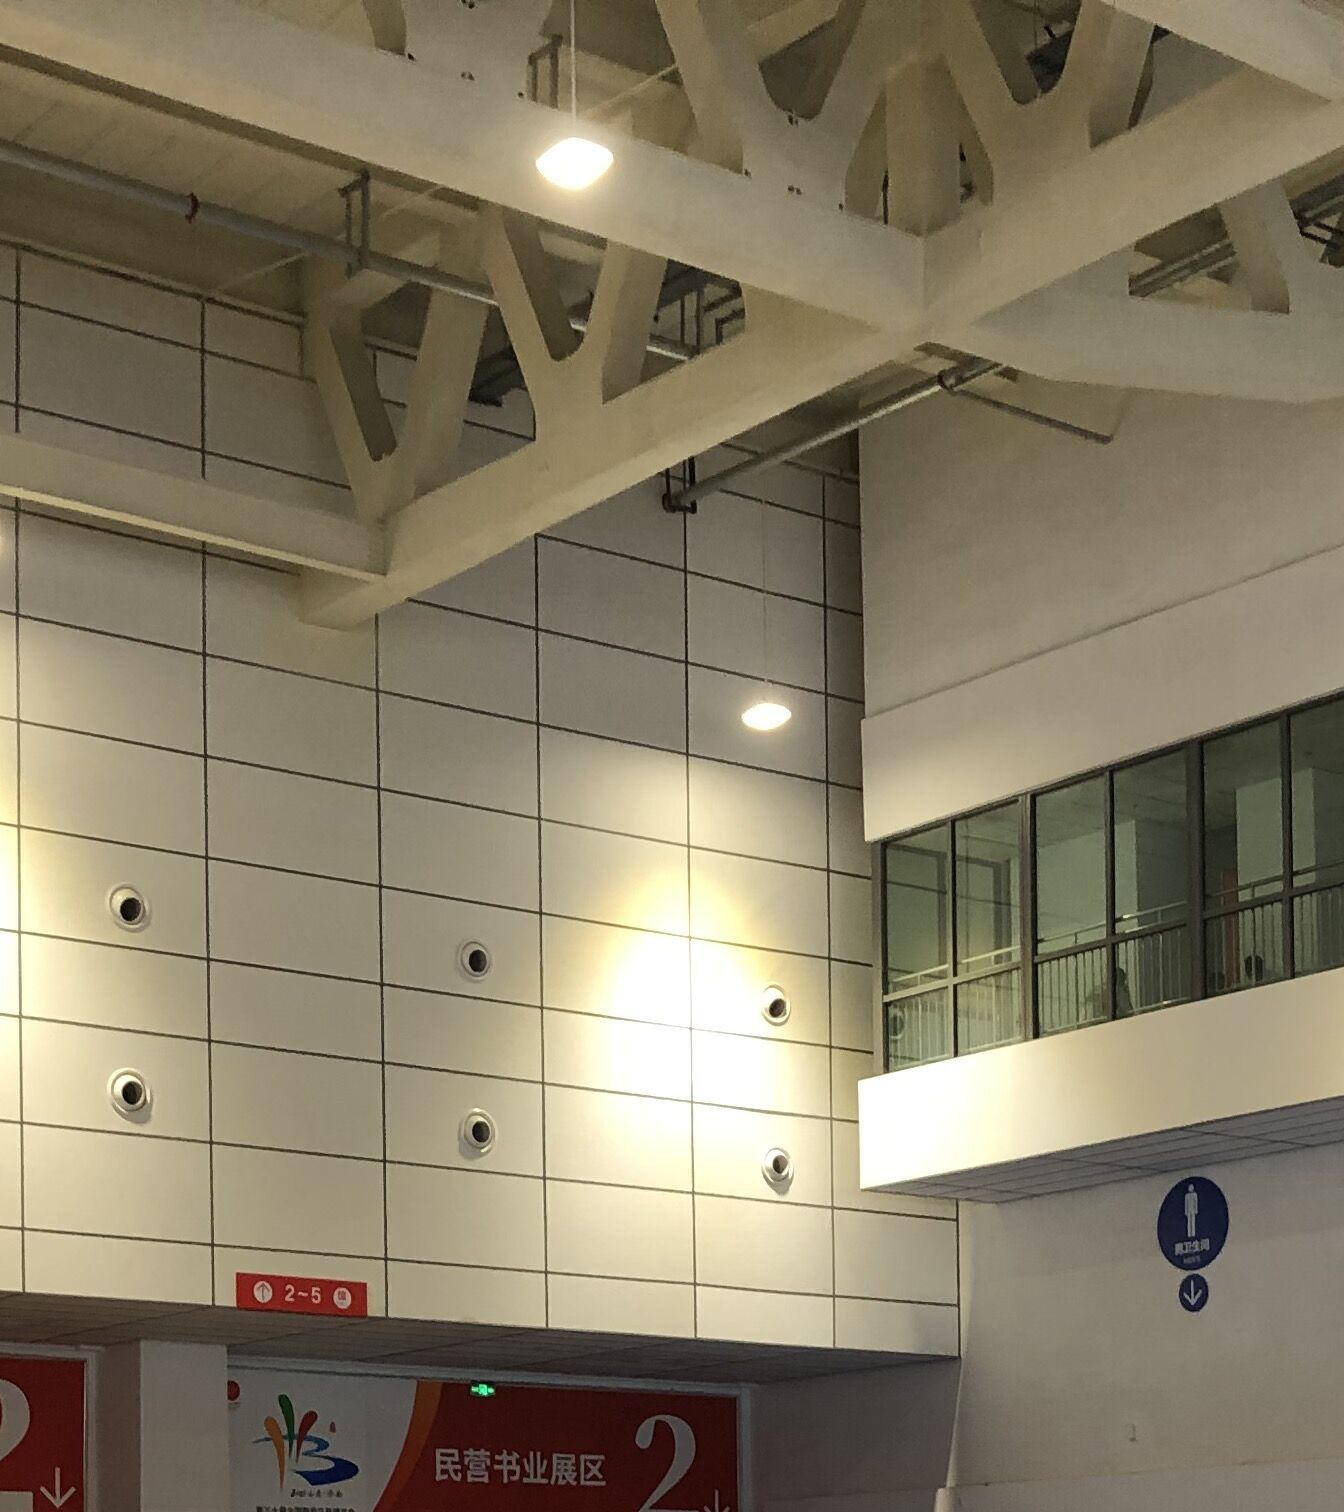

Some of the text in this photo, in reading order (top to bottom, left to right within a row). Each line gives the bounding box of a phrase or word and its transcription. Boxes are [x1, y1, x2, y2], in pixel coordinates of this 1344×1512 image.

[434, 1447, 607, 1487] 民营书业展区
